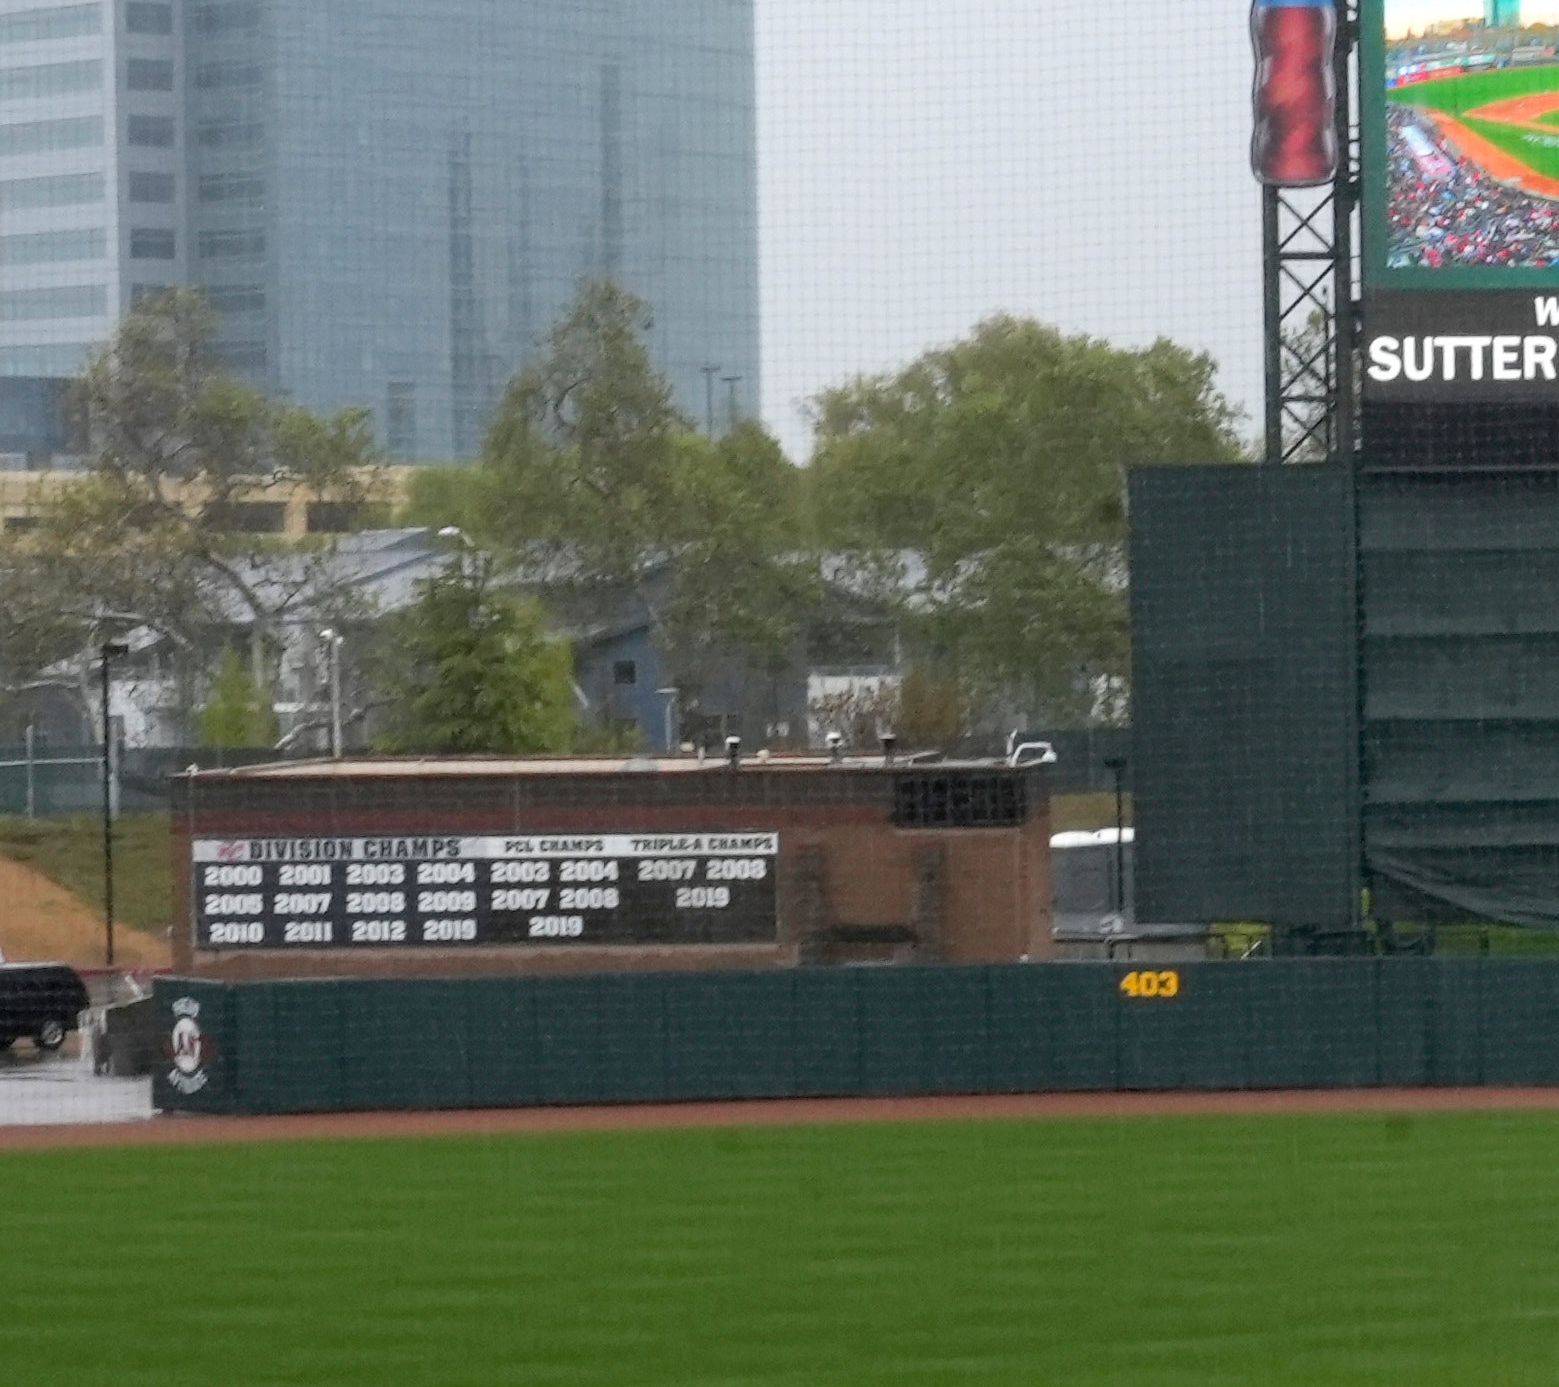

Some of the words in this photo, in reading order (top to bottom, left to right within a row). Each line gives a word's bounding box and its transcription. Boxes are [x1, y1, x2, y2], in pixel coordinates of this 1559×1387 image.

[1367, 336, 1557, 381] SUTTER
[249, 839, 353, 860] DIVISION
[363, 838, 462, 858] CHAMPS
[505, 840, 534, 853] PCL
[540, 839, 603, 852] CHAMPS
[708, 837, 773, 851] CHAMPS
[204, 865, 263, 887] 2000
[279, 864, 332, 886] 2001
[346, 863, 406, 885] 2003
[417, 862, 476, 884] 2004
[559, 860, 619, 882] 2004
[638, 860, 697, 881] 2007
[273, 892, 332, 914] 2007
[491, 888, 551, 911] 2007
[675, 886, 730, 908] 2019
[209, 921, 264, 943] 2010
[284, 920, 333, 942] 2011
[351, 919, 407, 941] 2012
[423, 918, 477, 941] 2019
[529, 915, 584, 938] 2019
[1119, 970, 1180, 999] 403
